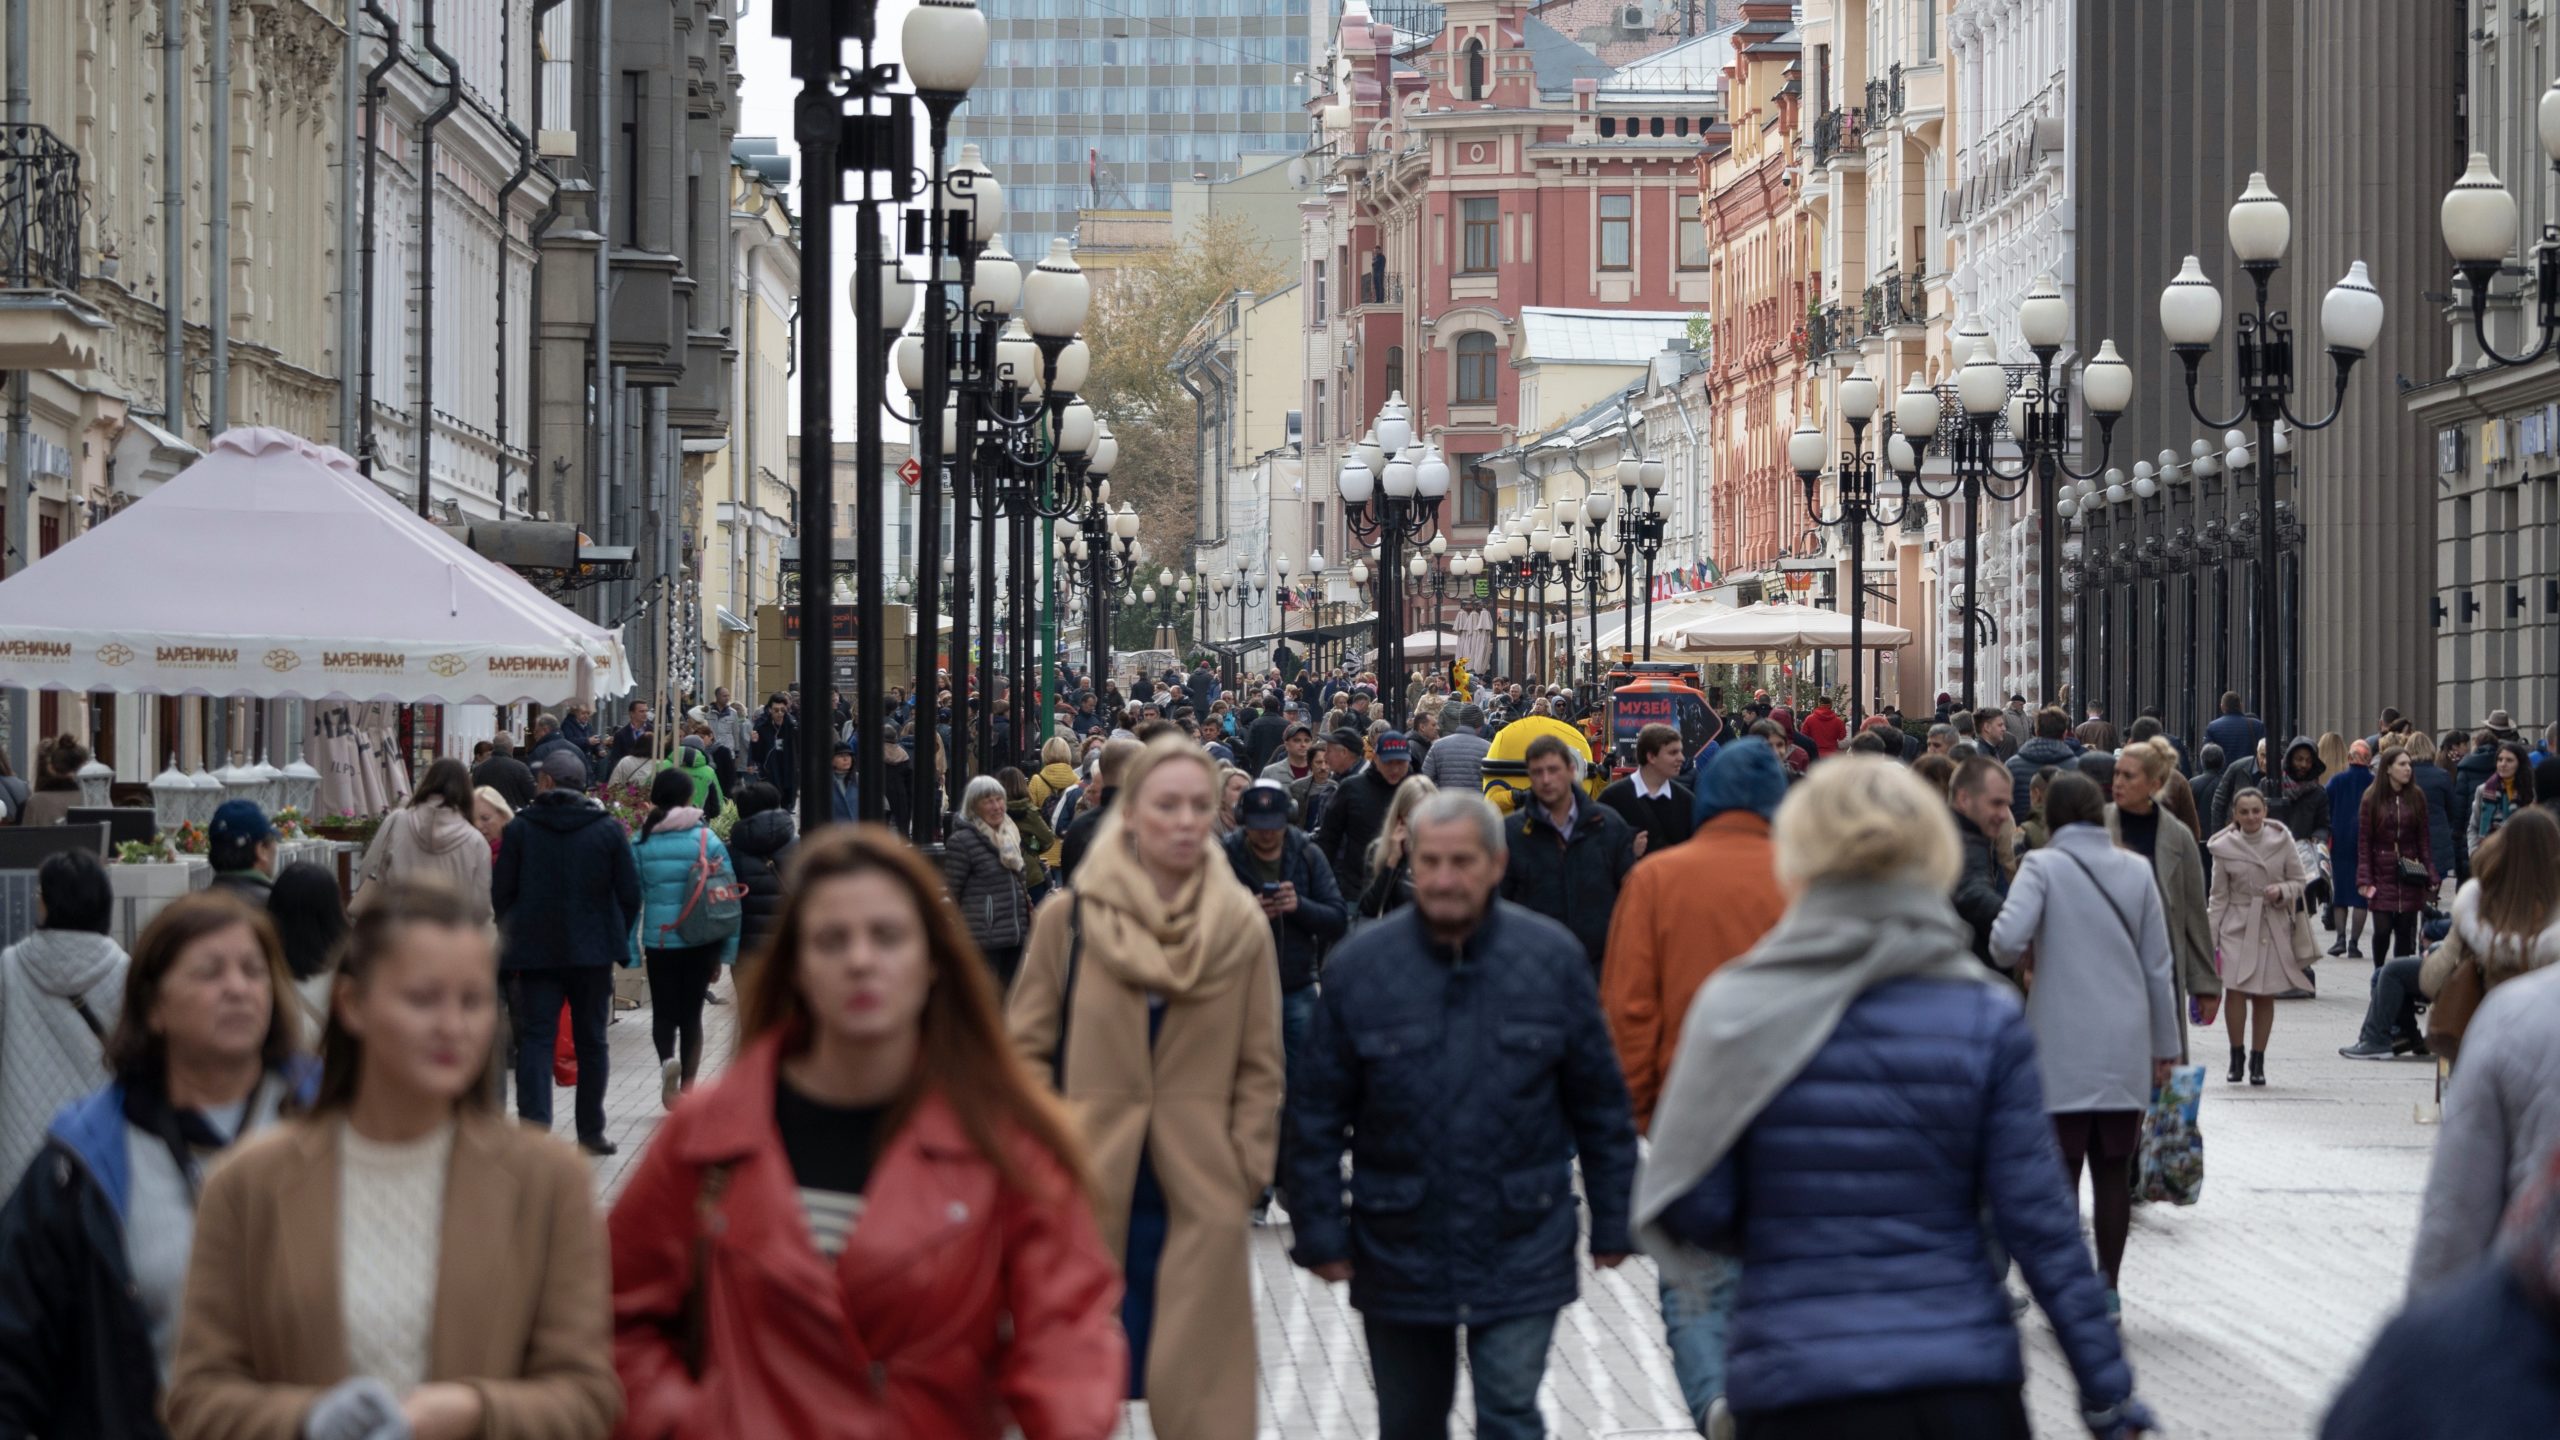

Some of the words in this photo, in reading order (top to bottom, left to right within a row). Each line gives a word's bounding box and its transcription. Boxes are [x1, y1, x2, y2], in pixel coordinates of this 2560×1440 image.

[0, 640, 72, 656] АРЕНИЧНАЯ
[156, 646, 238, 662] ВАРЕНИЧНАЯ
[323, 652, 405, 668] ВАРЕНИЧНАЯ
[488, 656, 570, 671] ВАРЕНИЧНАЯ
[1618, 698, 1671, 714] МУЗЕЙ
